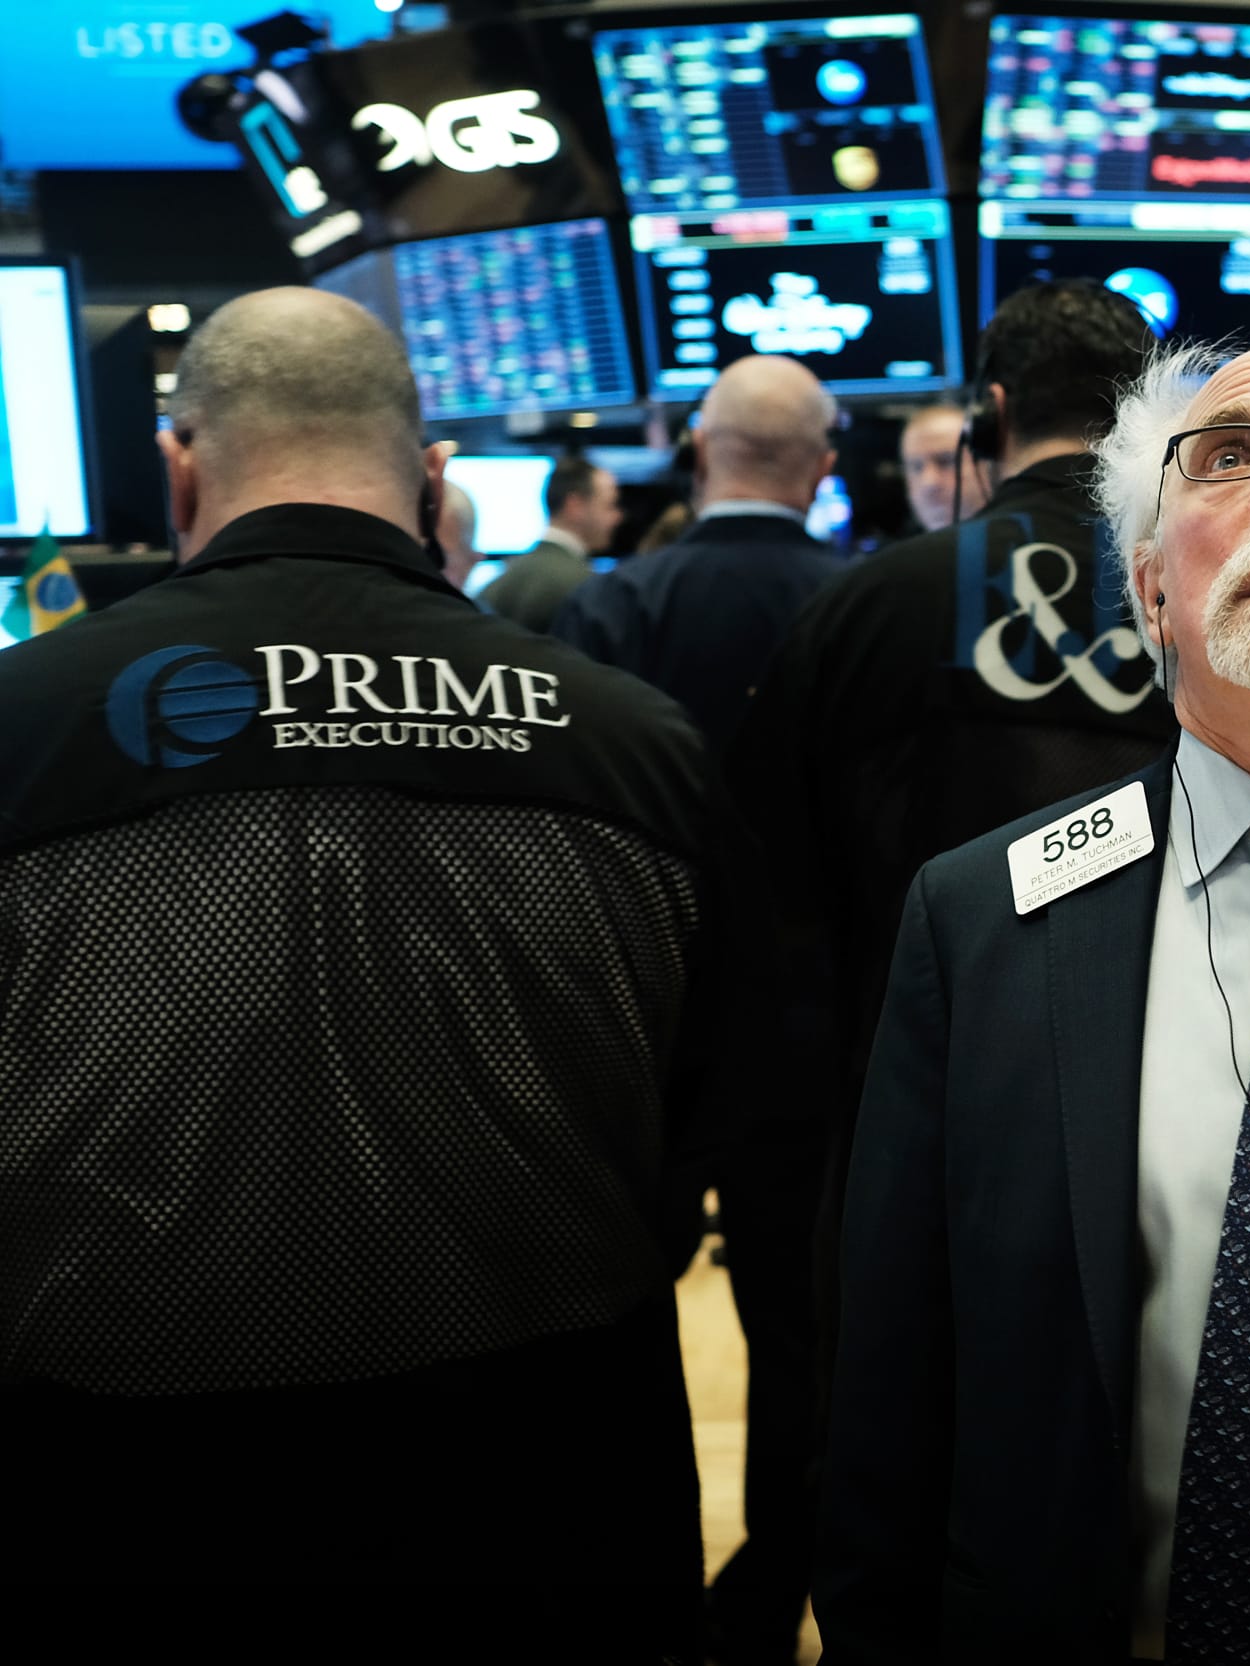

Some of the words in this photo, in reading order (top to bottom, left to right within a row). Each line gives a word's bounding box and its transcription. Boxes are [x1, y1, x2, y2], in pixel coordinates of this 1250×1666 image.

[76, 22, 232, 58] LISTED
[254, 644, 571, 727] PRIME
[272, 722, 532, 752] EXECUTIONS
[1030, 864, 1064, 887] PETER
[1081, 831, 1133, 861] TUCHMAN
[1043, 807, 1114, 863] 588
[1024, 881, 1066, 907] QUATTRO
[1068, 876, 1077, 886] M
[1078, 853, 1127, 881] SECURITIES
